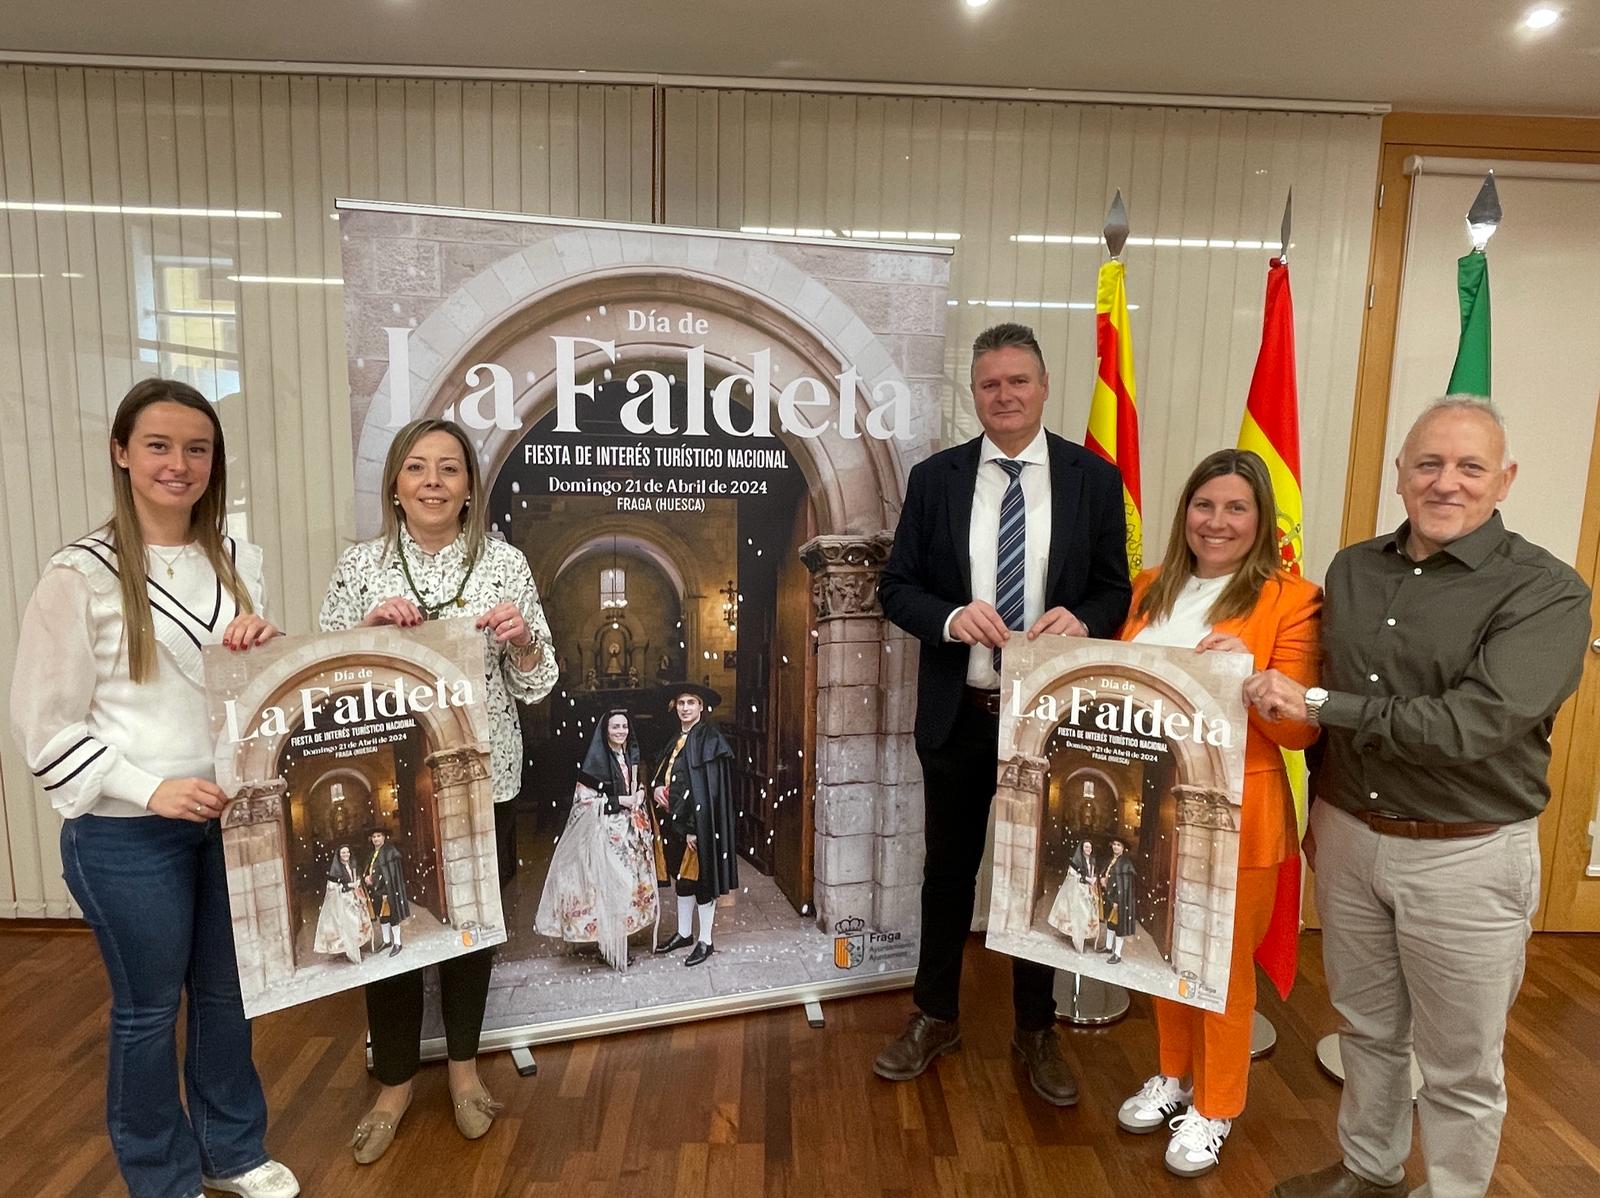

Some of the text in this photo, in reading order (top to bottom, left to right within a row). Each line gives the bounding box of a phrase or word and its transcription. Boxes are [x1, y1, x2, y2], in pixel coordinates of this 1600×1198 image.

[628, 309, 709, 335] Día de
[384, 327, 917, 440] La Faldeta
[524, 442, 789, 469] FIESTA DE INTERÉS TURÍSTICO NACIONAL
[549, 476, 768, 497] Domingo 21 de Abril de 2024
[617, 497, 706, 513] FRAGA (HUESCA)
[333, 668, 373, 683] Día de
[1100, 678, 1136, 692] Día de
[223, 676, 478, 743] La Faldeta
[1011, 679, 1235, 749] La Faldeta
[290, 718, 417, 747] FIESTA DE INTERÉS TURÍSTICO NACIONAL
[302, 745, 338, 757] Domingo
[338, 742, 347, 750] 21
[347, 741, 357, 749] de
[358, 738, 378, 749] Abril
[388, 732, 407, 743] 2024
[1057, 726, 1076, 738] FIESTA
[1076, 729, 1084, 739] DE
[1085, 731, 1108, 743] INTERÉS
[1139, 739, 1169, 753] NACIONAL
[1066, 740, 1096, 752] Domingo
[1103, 746, 1112, 755] de
[1140, 753, 1158, 763] 2024
[869, 931, 901, 944] Fraga
